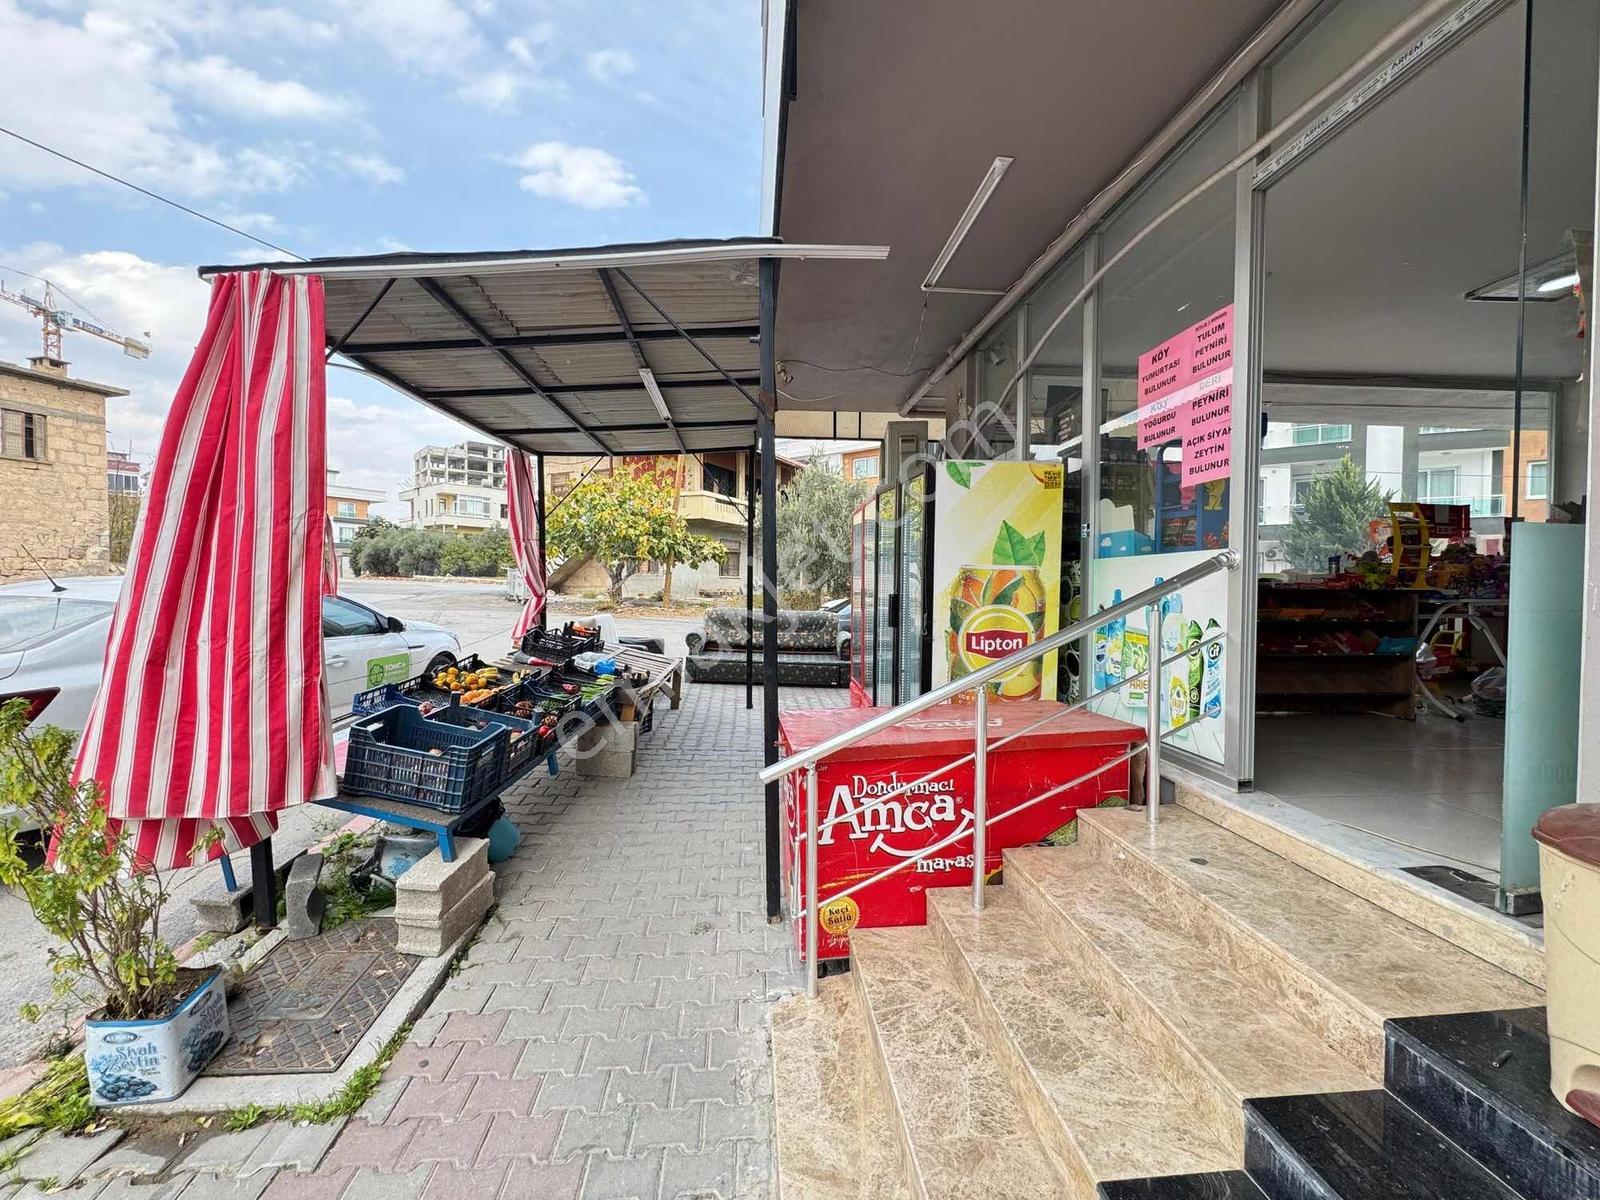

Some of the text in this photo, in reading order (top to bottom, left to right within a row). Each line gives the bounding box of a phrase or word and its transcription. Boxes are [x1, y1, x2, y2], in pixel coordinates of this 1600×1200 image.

[1197, 322, 1225, 342] TULUM
[1195, 334, 1227, 357] PEYNİRİ
[1152, 347, 1170, 365] KÖY
[1192, 349, 1231, 373] BULUNUR
[1145, 375, 1177, 395] BULUNUR
[1192, 385, 1229, 410] PEYNİRİ
[1144, 411, 1176, 429] YOĞURDU
[1191, 405, 1230, 426] BULUNUR
[1144, 426, 1176, 443] BULUNUR
[1186, 433, 1205, 448] AÇIK
[1194, 443, 1225, 459] ZEYTİN
[1189, 458, 1230, 475] BULUNUR
[971, 635, 1023, 654] Lipton
[818, 784, 956, 846] Amca
